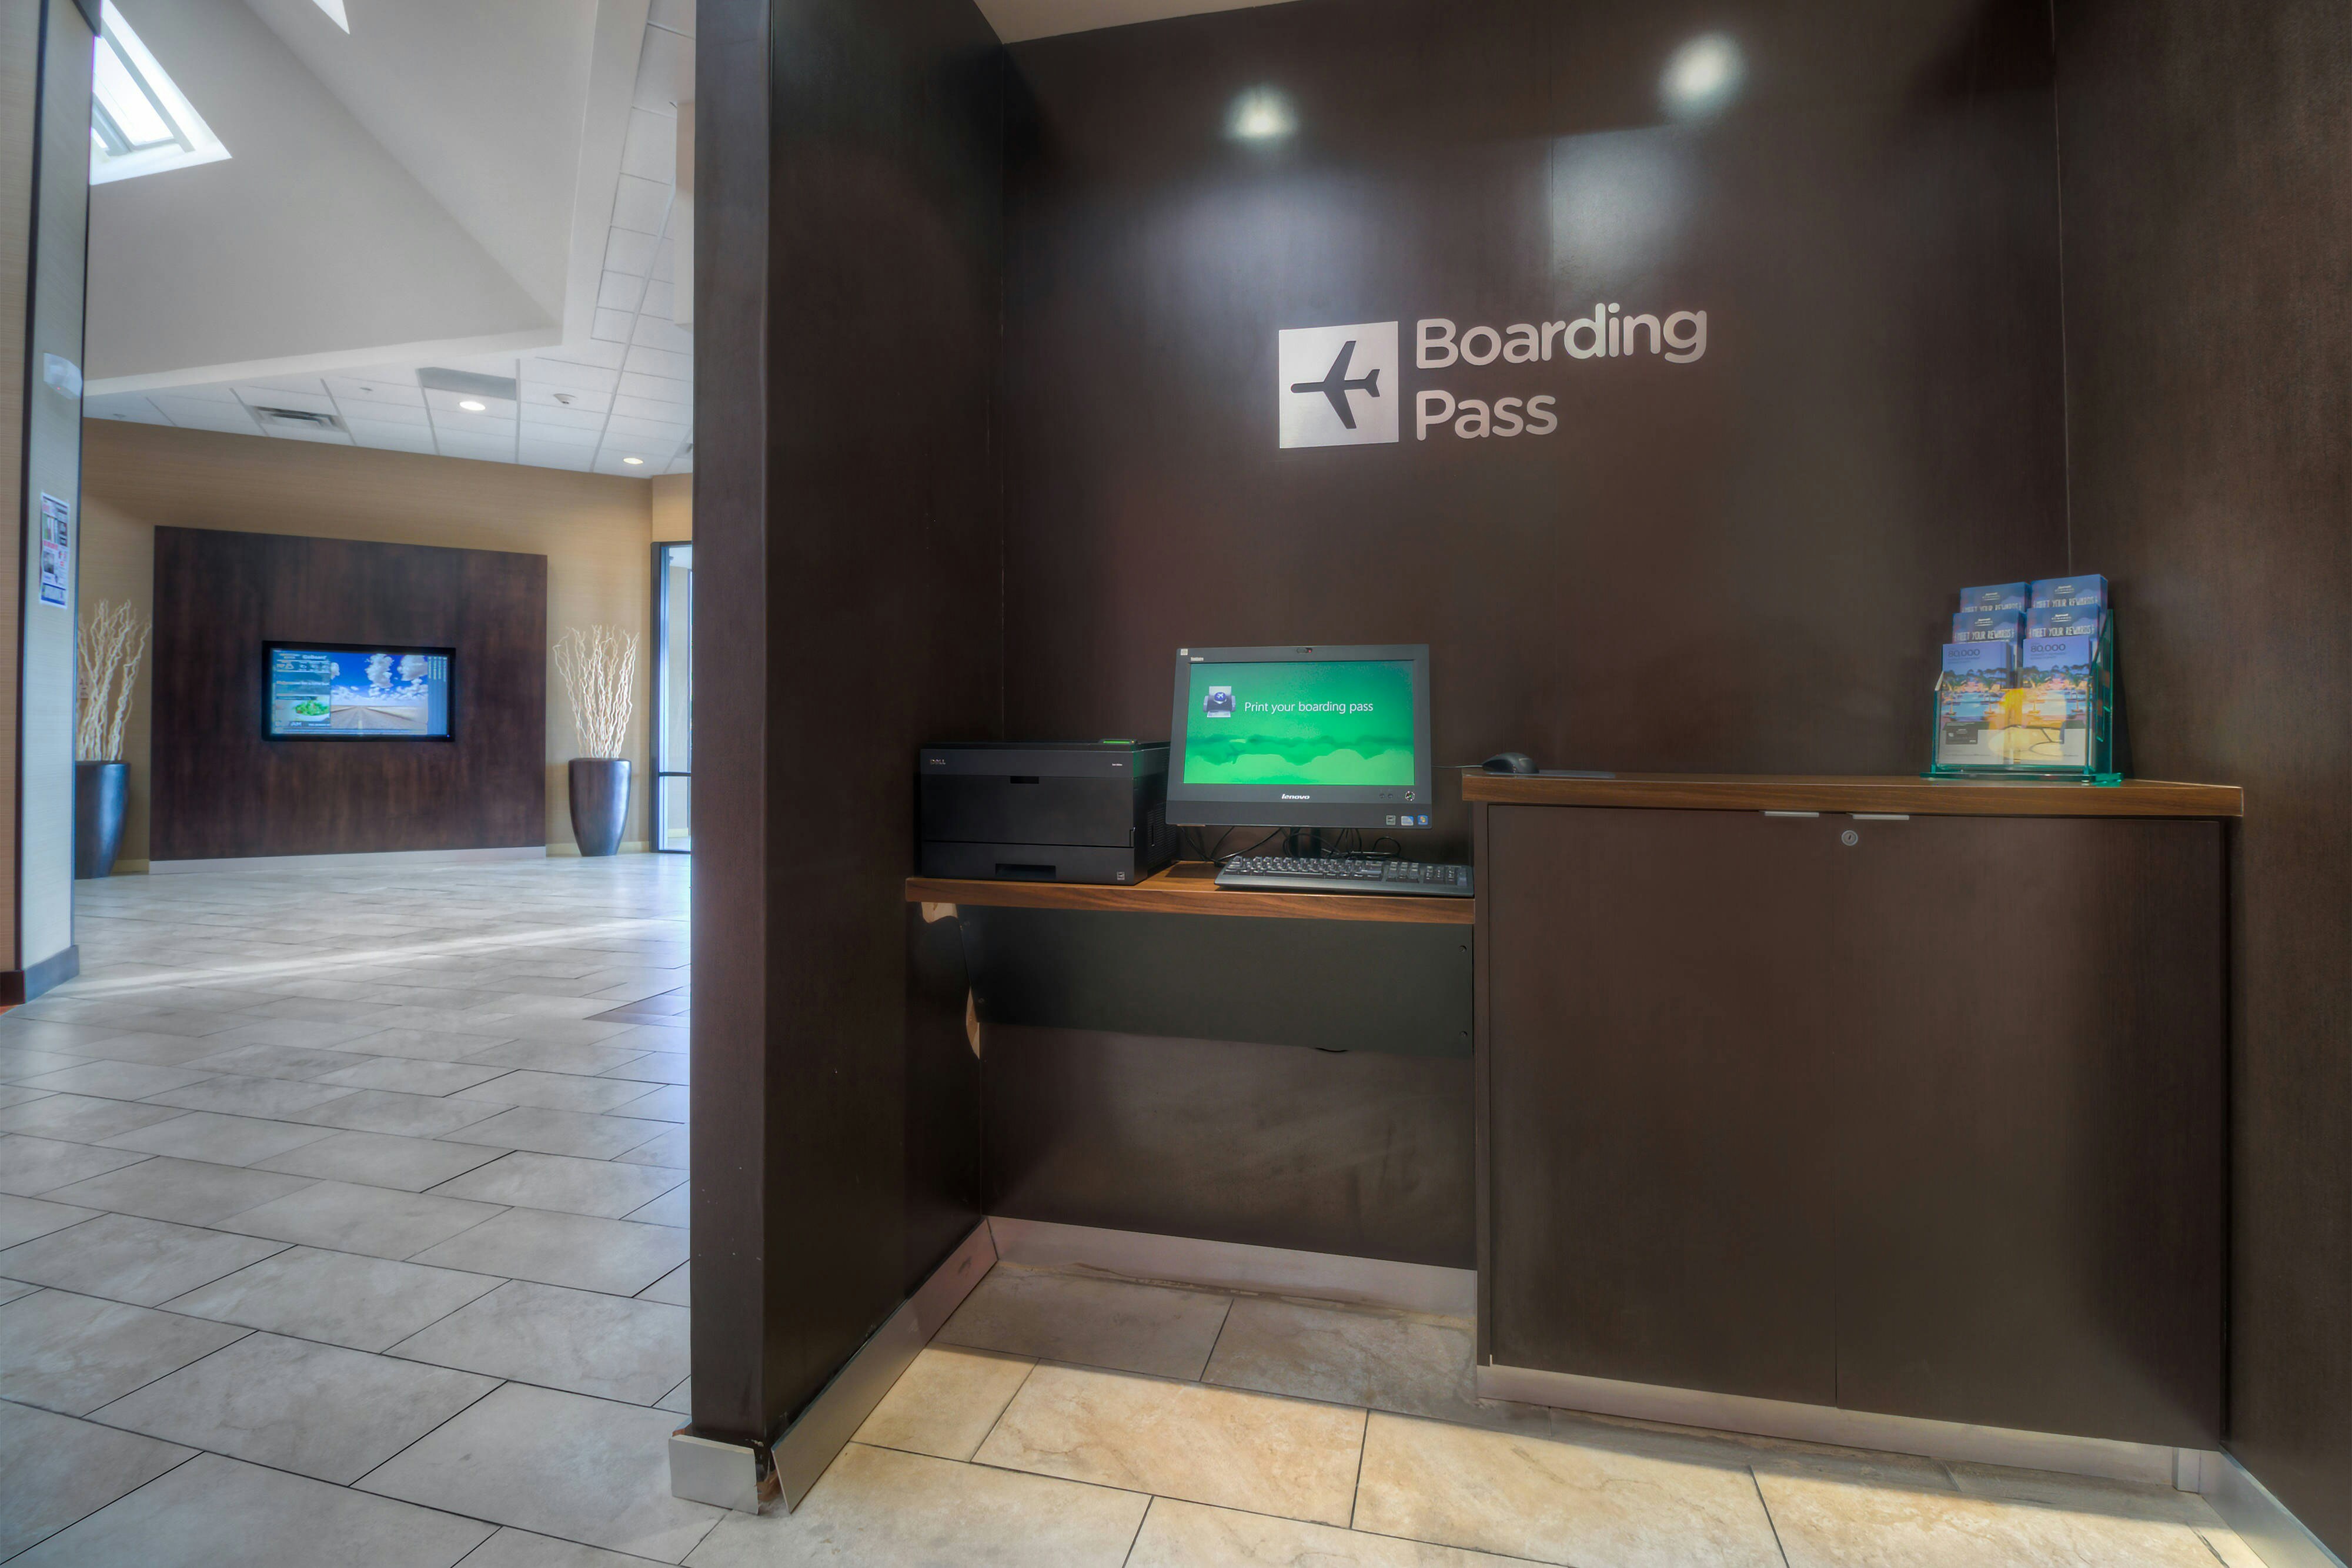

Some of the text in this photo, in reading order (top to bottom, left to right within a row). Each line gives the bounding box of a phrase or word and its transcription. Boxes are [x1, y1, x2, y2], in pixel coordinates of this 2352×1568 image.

[1416, 303, 1707, 369] Boarding
[1416, 390, 1558, 441] Pass
[1244, 701, 1374, 714] Print your boarding pass
